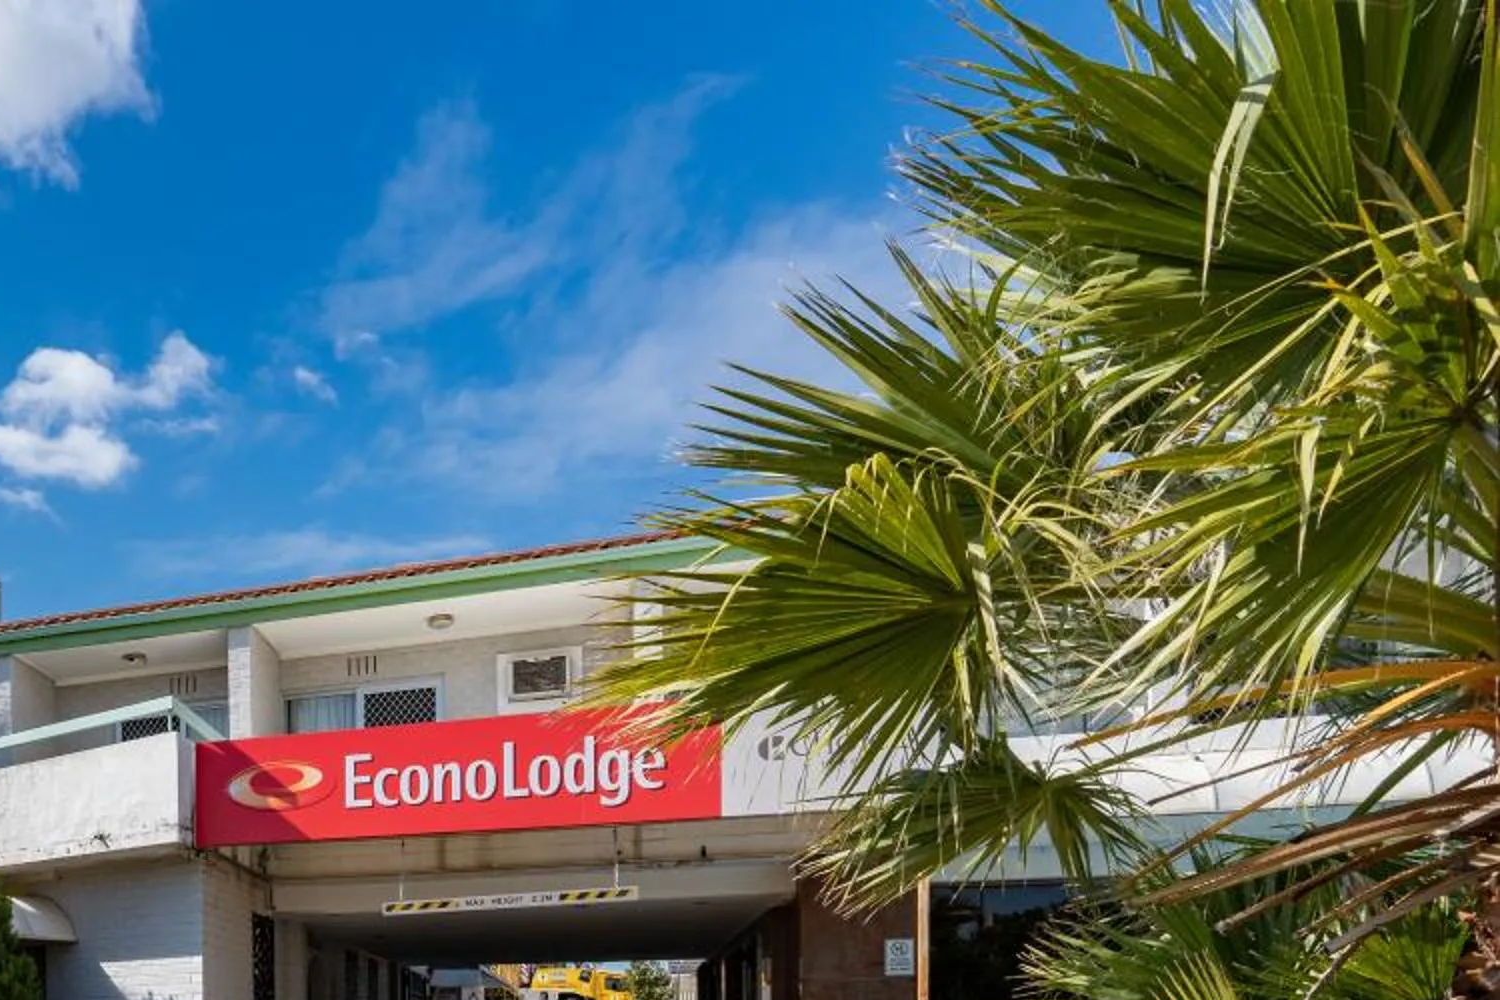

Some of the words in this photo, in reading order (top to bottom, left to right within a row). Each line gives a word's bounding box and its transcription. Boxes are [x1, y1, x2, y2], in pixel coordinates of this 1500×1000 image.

[344, 735, 667, 807] EconoLodge
[465, 895, 484, 906] MAX
[491, 895, 523, 905] HEIGHT
